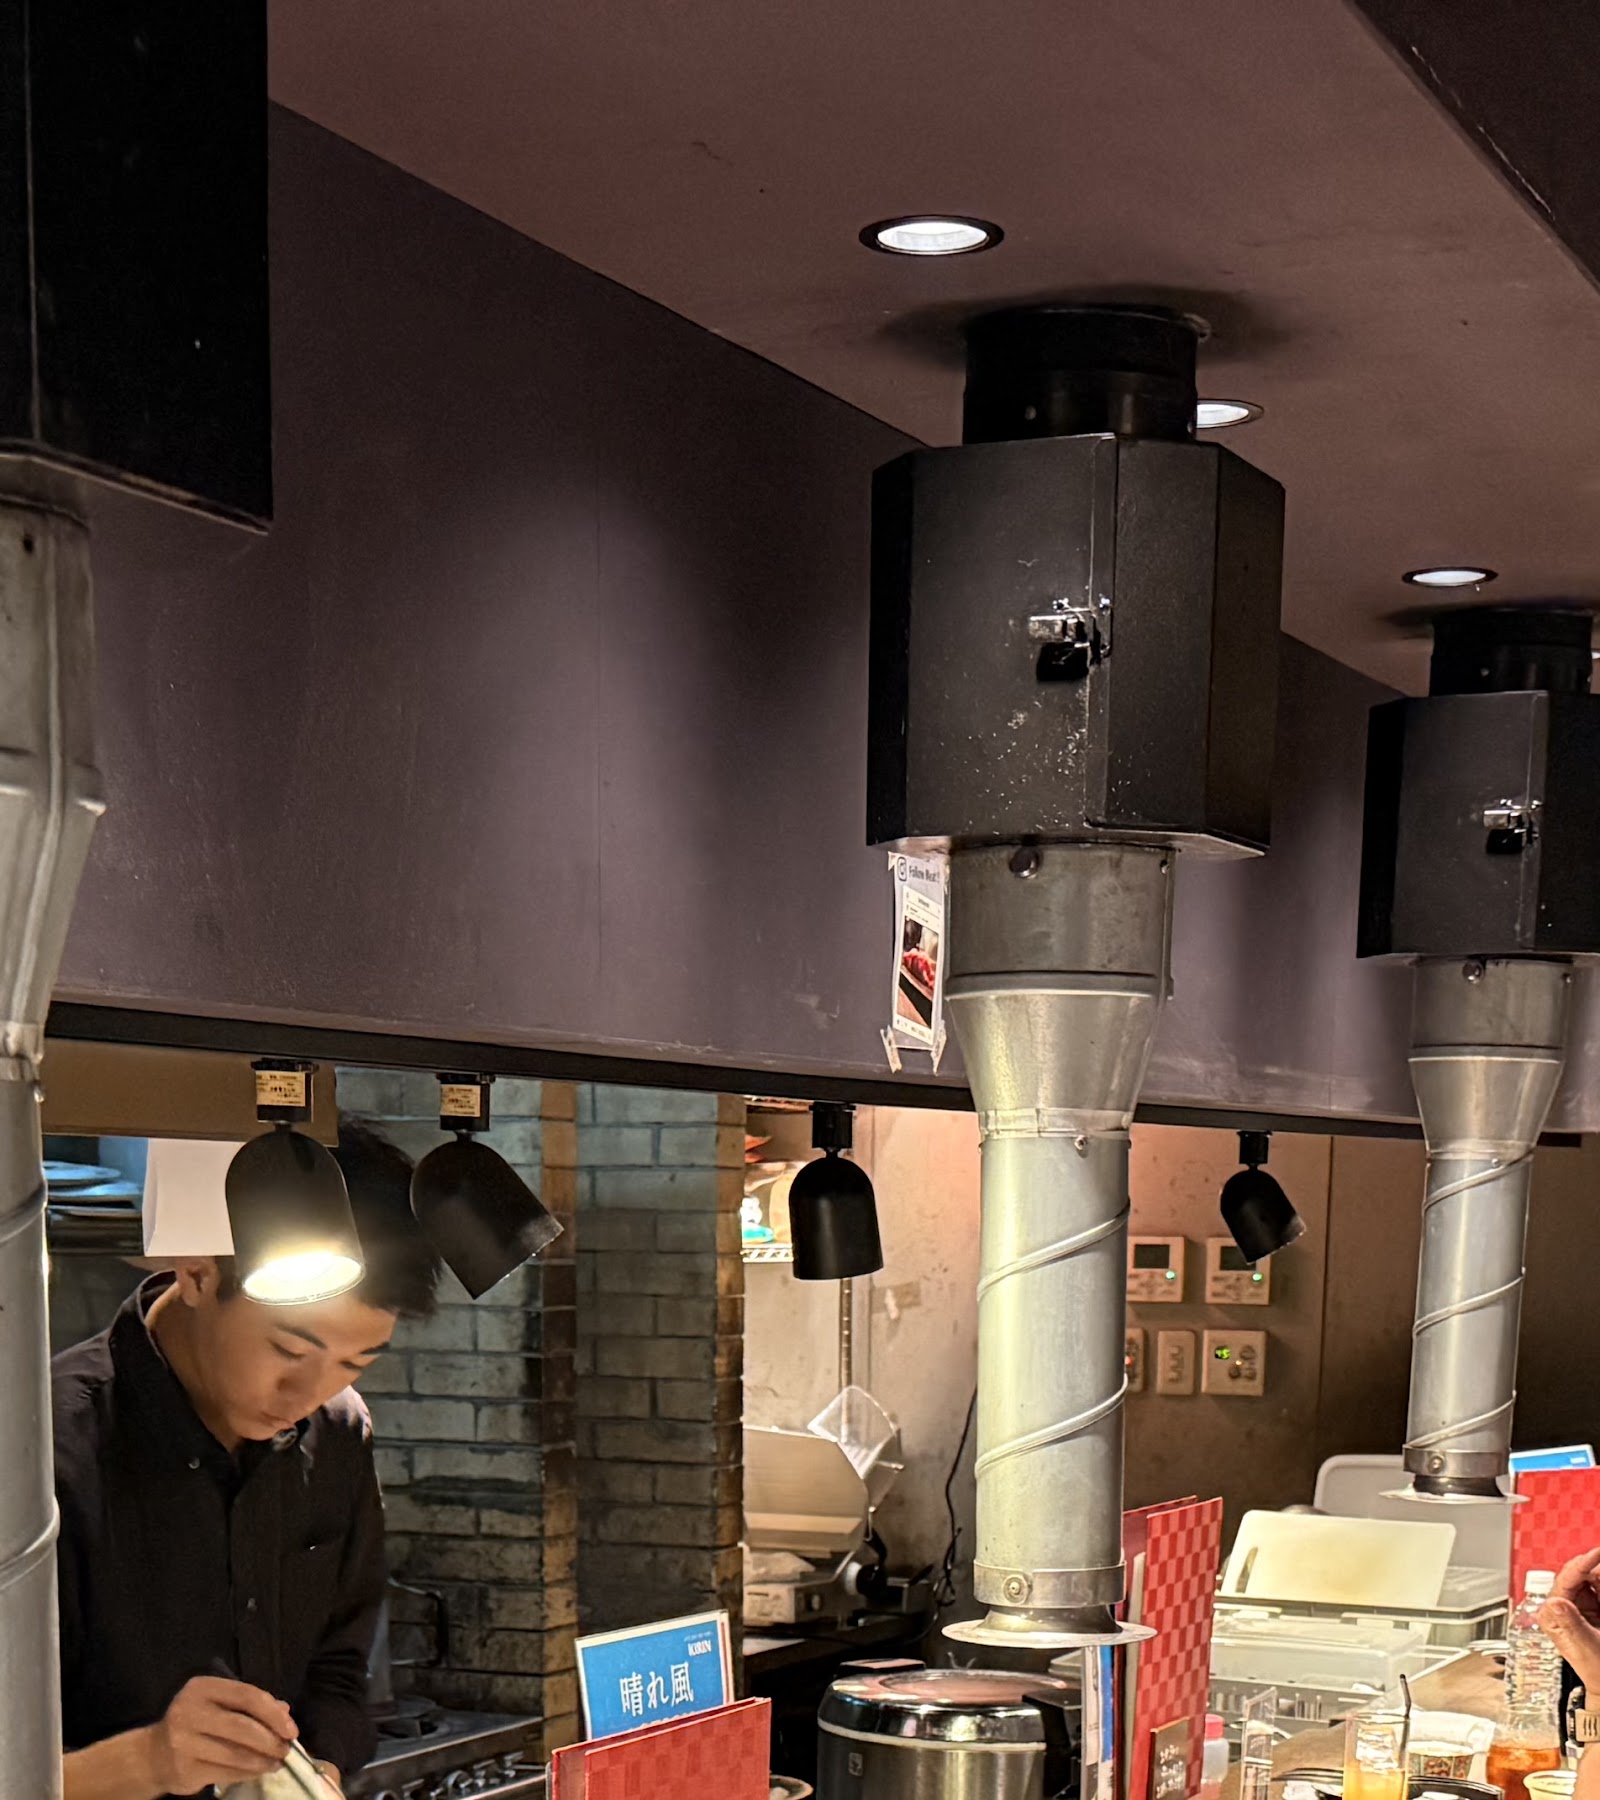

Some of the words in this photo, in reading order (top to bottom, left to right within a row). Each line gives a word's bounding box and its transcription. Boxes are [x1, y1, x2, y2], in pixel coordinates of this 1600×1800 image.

[687, 1639, 712, 1657] KIRIN
[619, 1661, 694, 1717] 晴れ風
